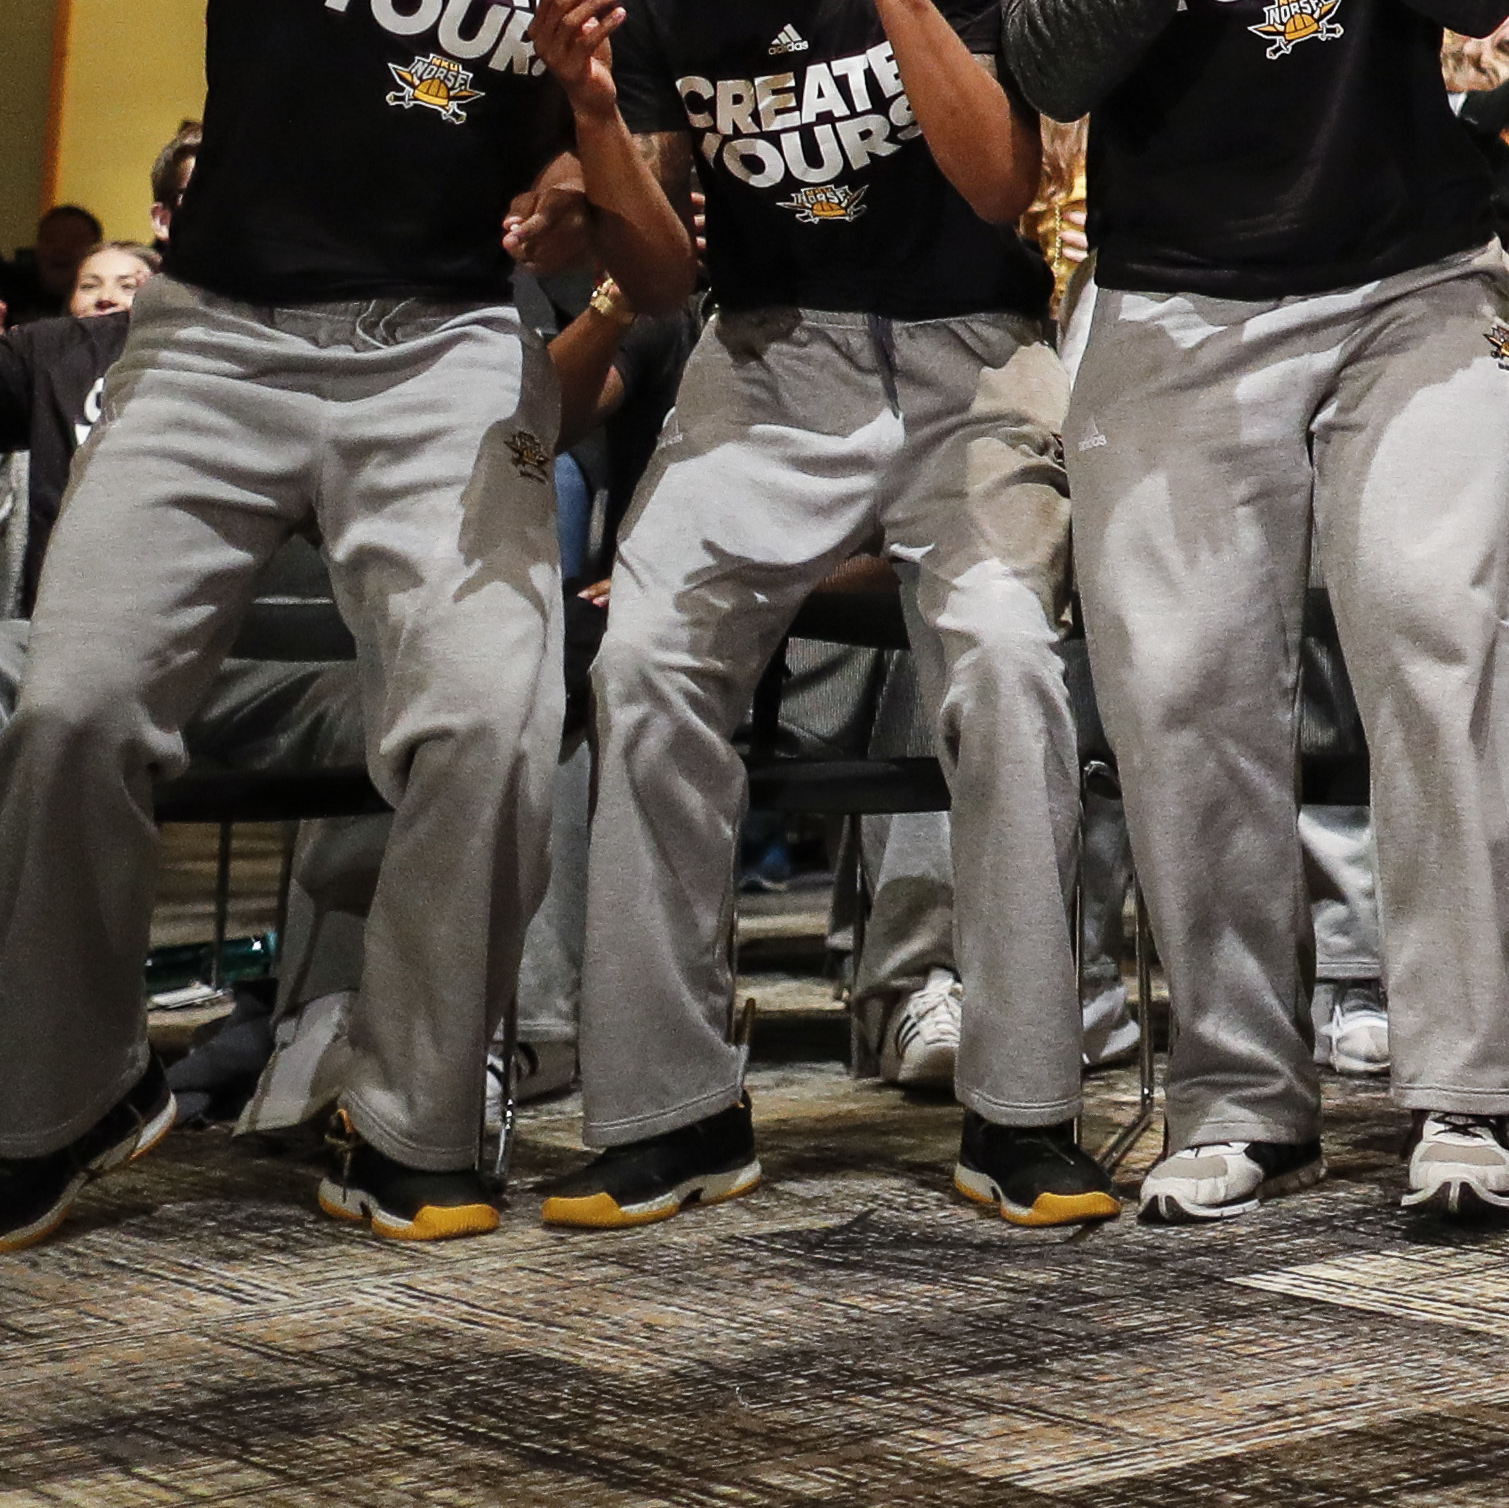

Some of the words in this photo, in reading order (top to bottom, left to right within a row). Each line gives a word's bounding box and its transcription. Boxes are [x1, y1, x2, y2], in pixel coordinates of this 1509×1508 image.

[768, 41, 809, 55] adidas
[411, 61, 468, 89] NORSE
[432, 57, 459, 72] NKU
[675, 41, 904, 135] CREATE
